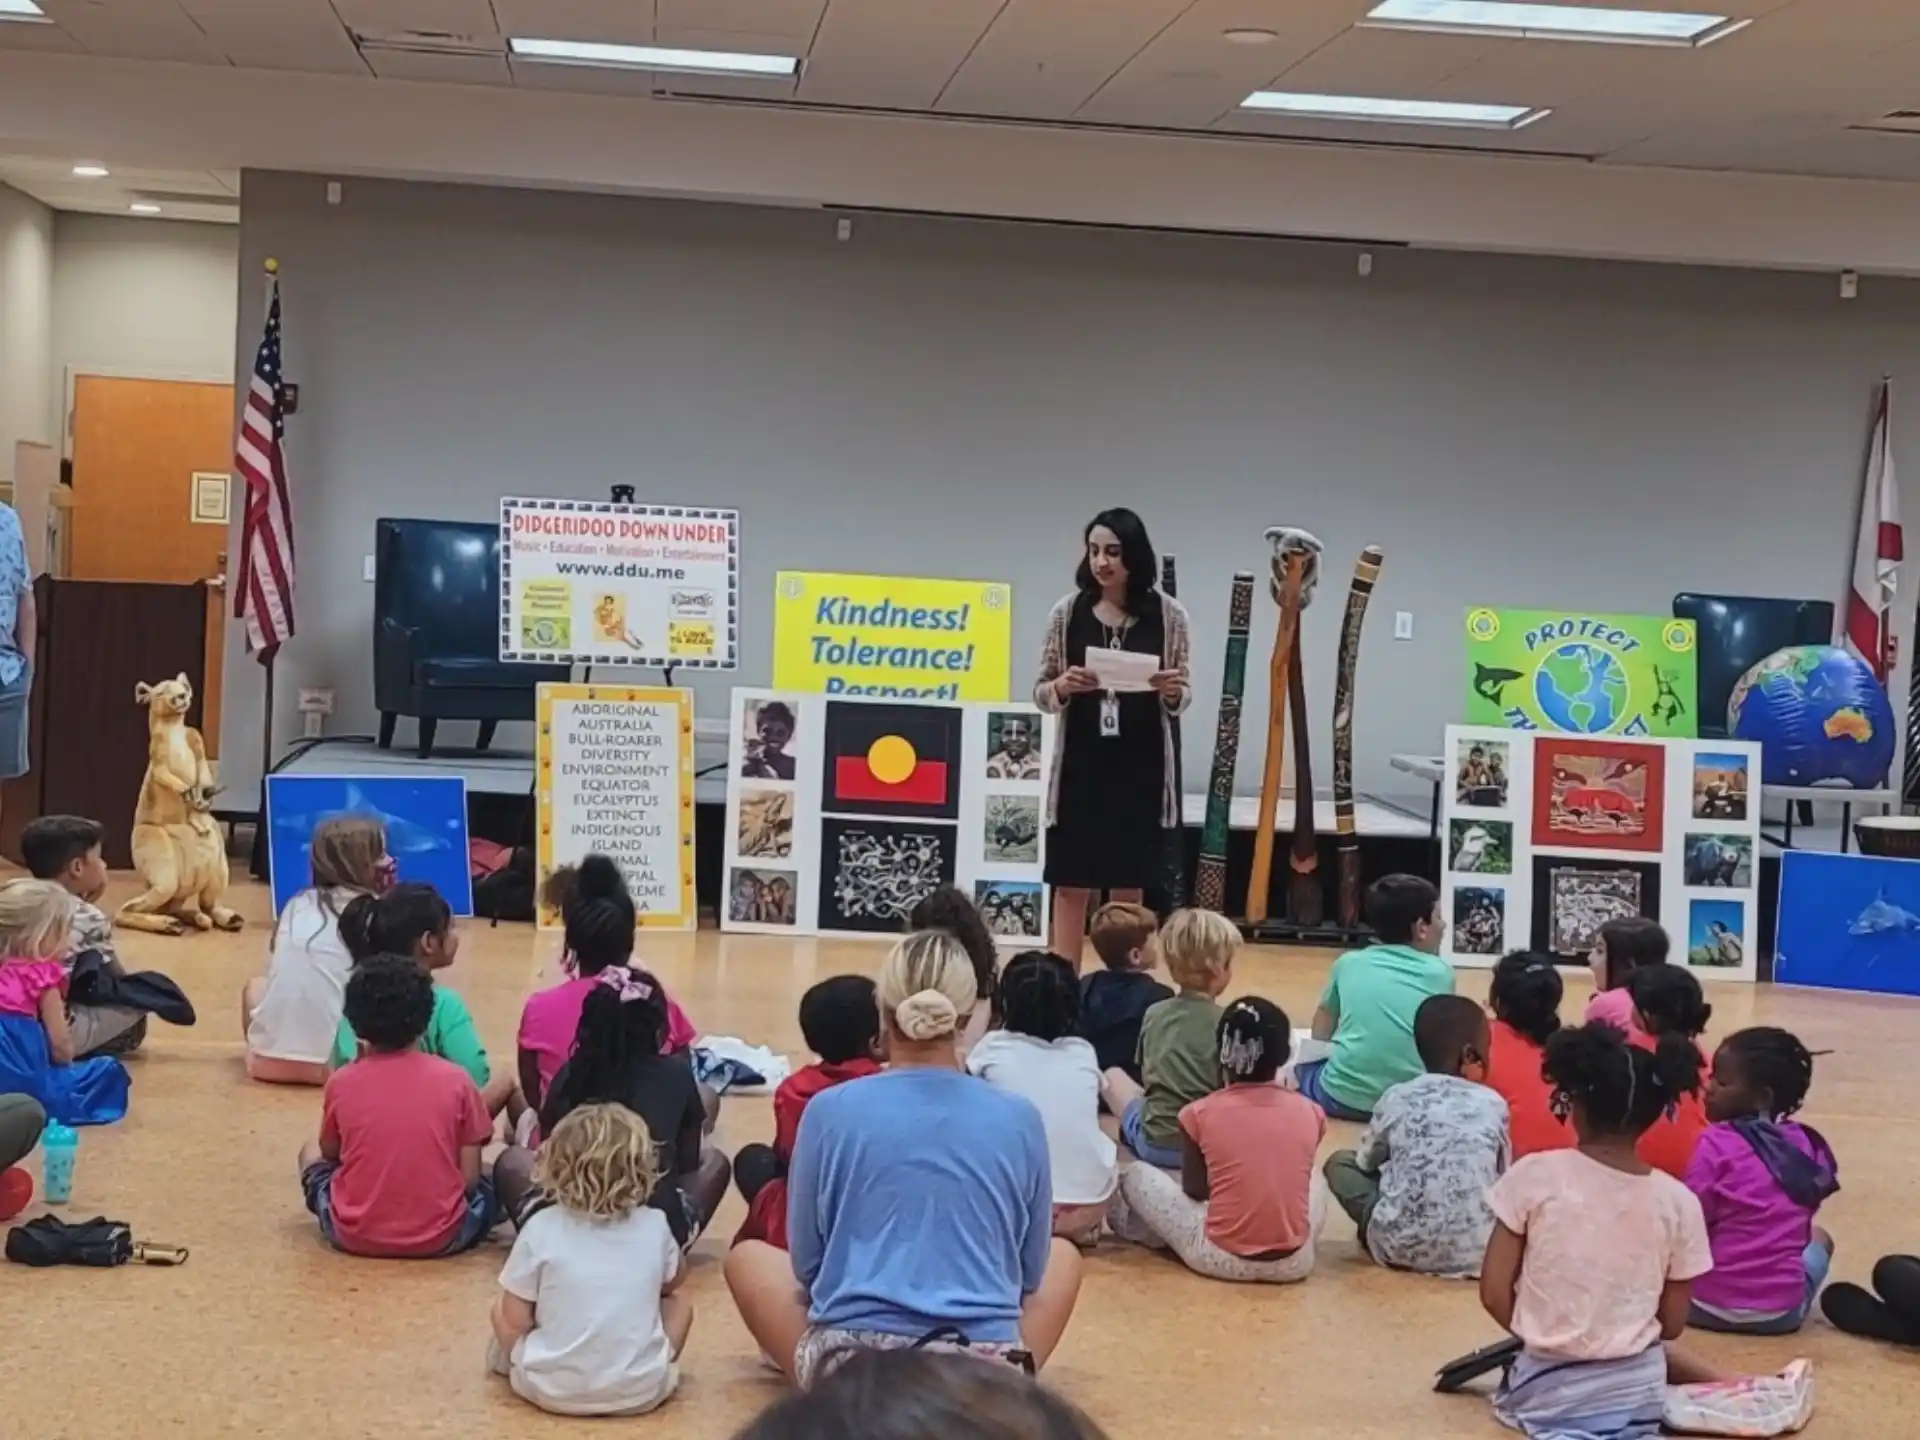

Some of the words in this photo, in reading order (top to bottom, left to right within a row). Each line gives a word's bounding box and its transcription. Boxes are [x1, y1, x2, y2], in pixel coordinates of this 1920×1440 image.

[514, 514, 615, 537] DIDGERIDOO
[619, 519, 669, 541] DOWN
[673, 523, 726, 545] UNDER
[556, 561, 686, 580] www.ddu.me
[815, 596, 970, 632] Kindness!
[1525, 620, 1641, 652] PROTECT
[811, 636, 975, 672] Tolerance!
[572, 703, 659, 717] ABORIGINAL
[578, 718, 653, 731] AUSTRALIA
[568, 733, 662, 746] BULL-ROARER
[580, 748, 651, 761] DIVERSITY
[562, 763, 670, 777] ENVIRONMENT
[581, 779, 650, 791] EQUATOR
[573, 793, 660, 807] EUCALYPTUS
[586, 809, 647, 821] EXTINCT
[571, 824, 662, 837] INDIGENOUS
[591, 839, 642, 851] ISLAND
